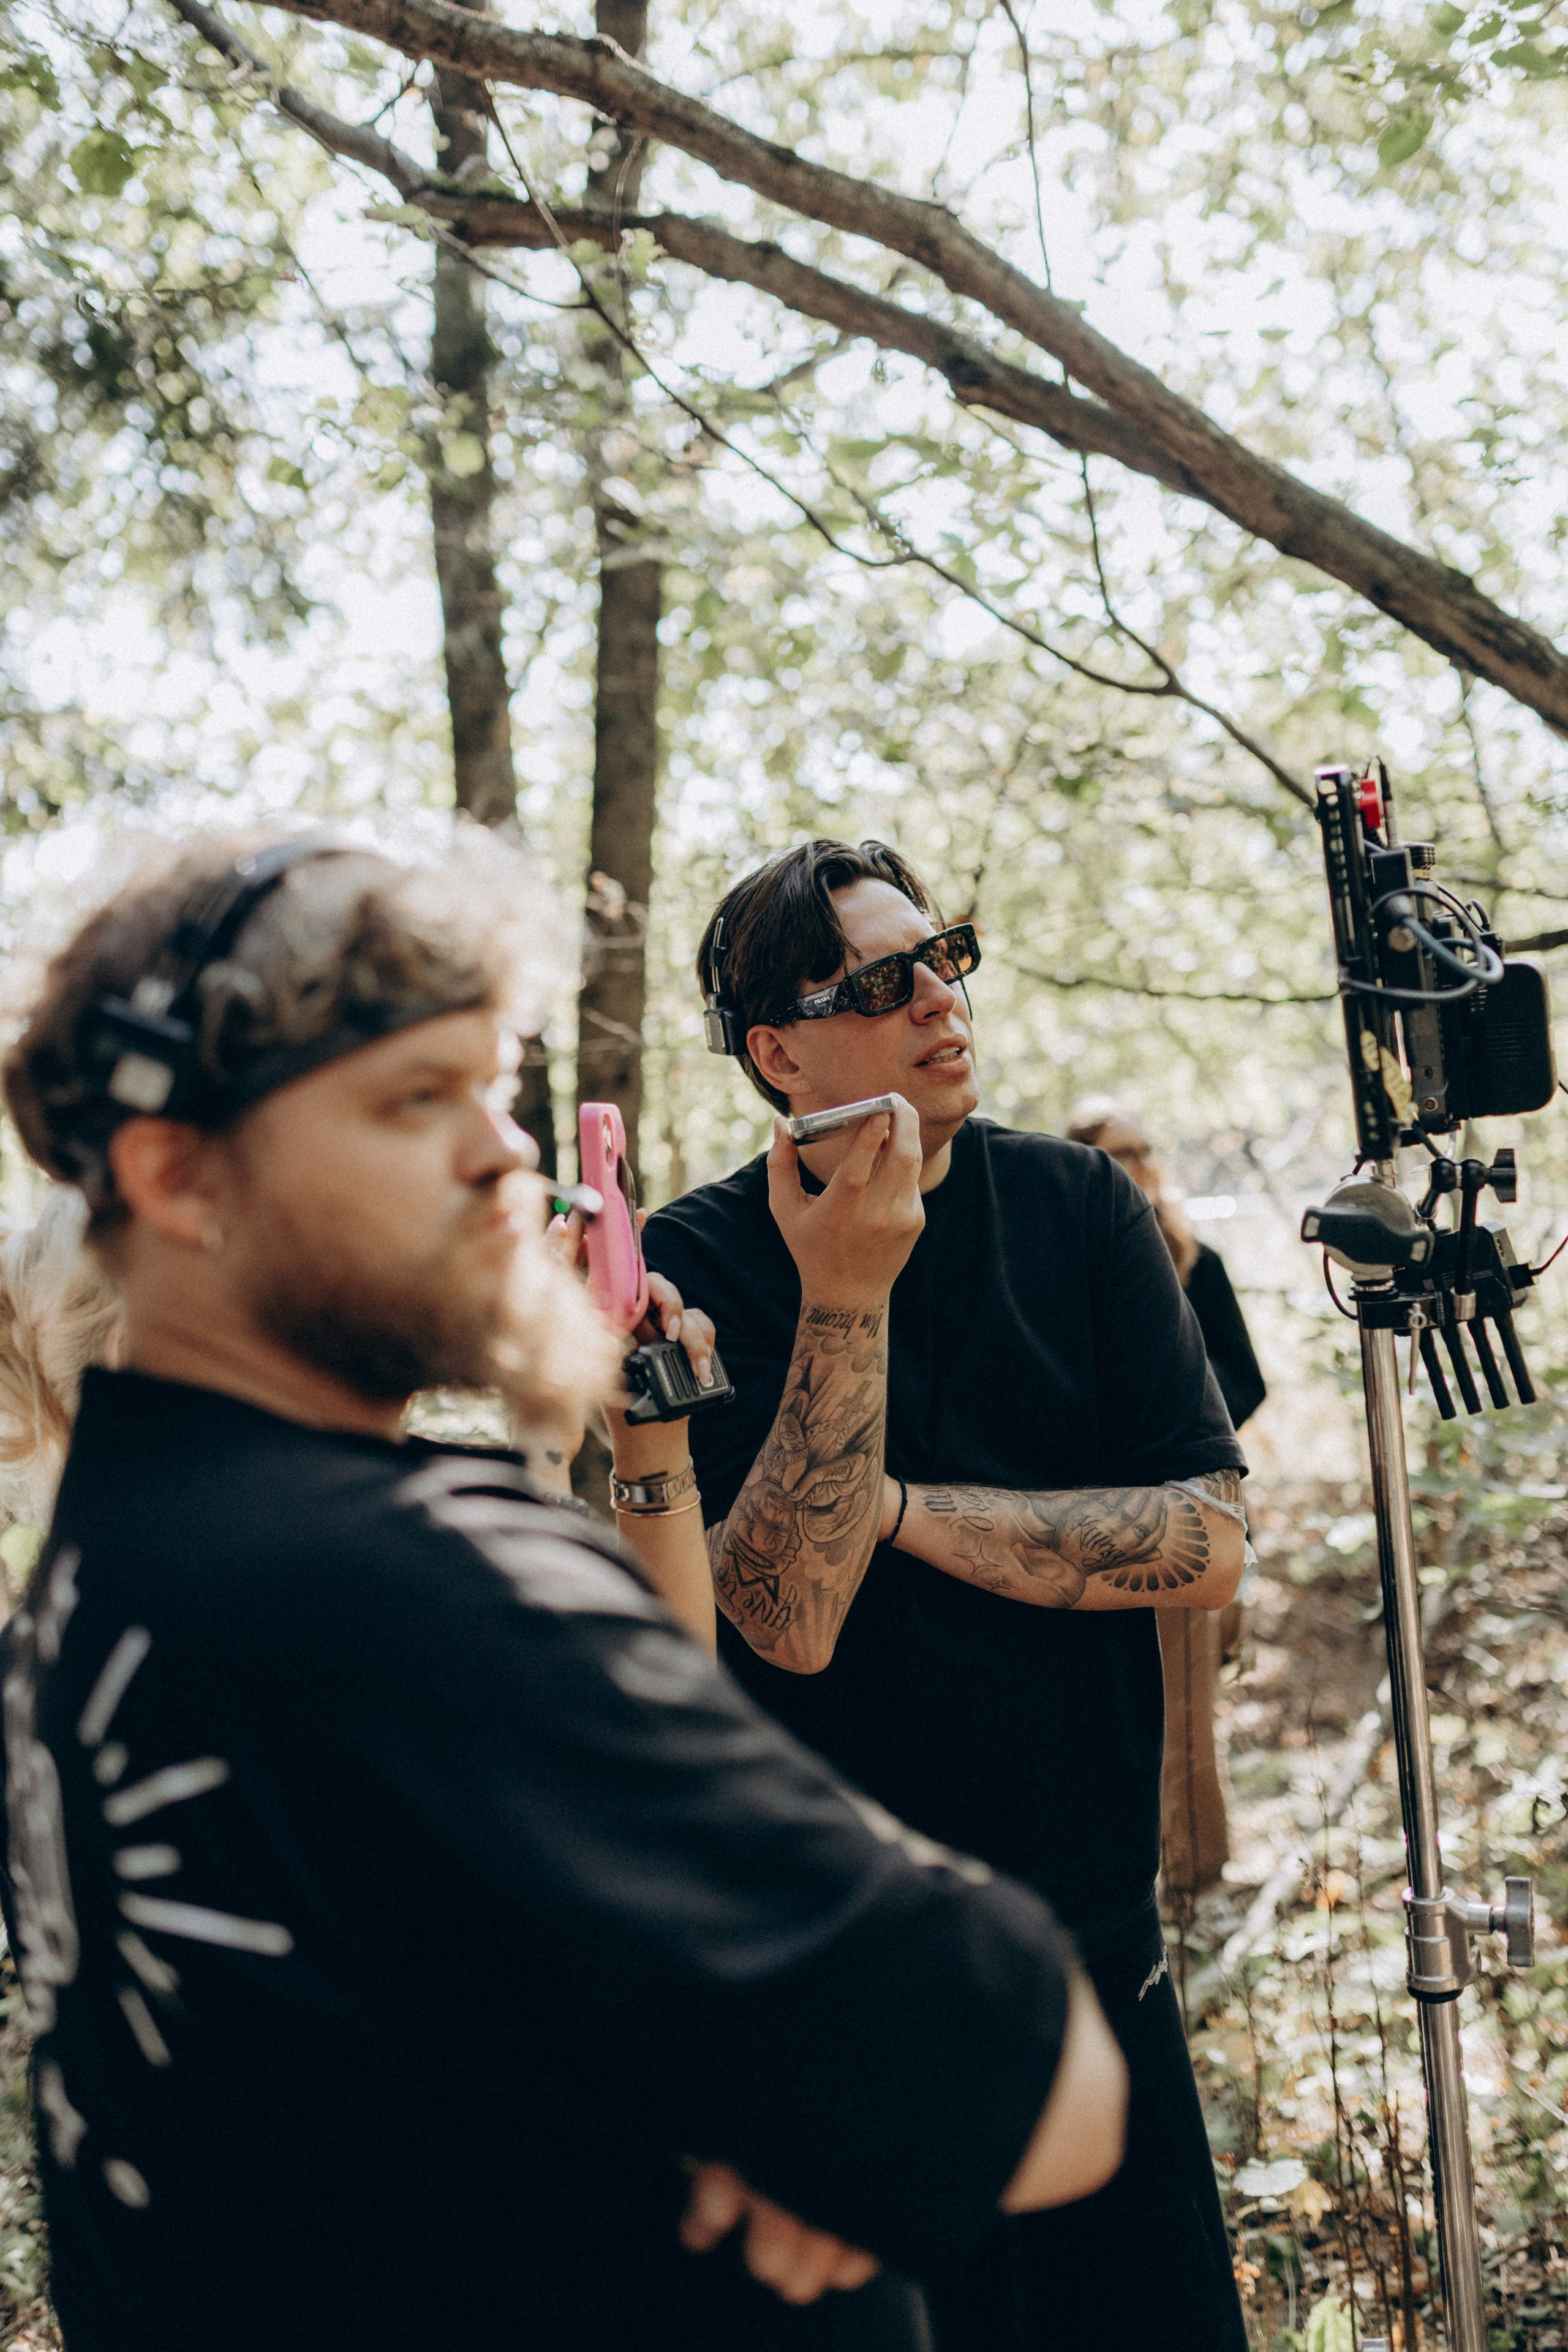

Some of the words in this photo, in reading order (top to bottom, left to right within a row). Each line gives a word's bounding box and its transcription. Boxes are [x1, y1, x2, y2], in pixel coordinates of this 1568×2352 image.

[813, 995, 831, 1005] PRADA
[805, 1308, 858, 1340] become
[859, 1305, 885, 1339] You
[822, 1460, 856, 1483] Kissed
